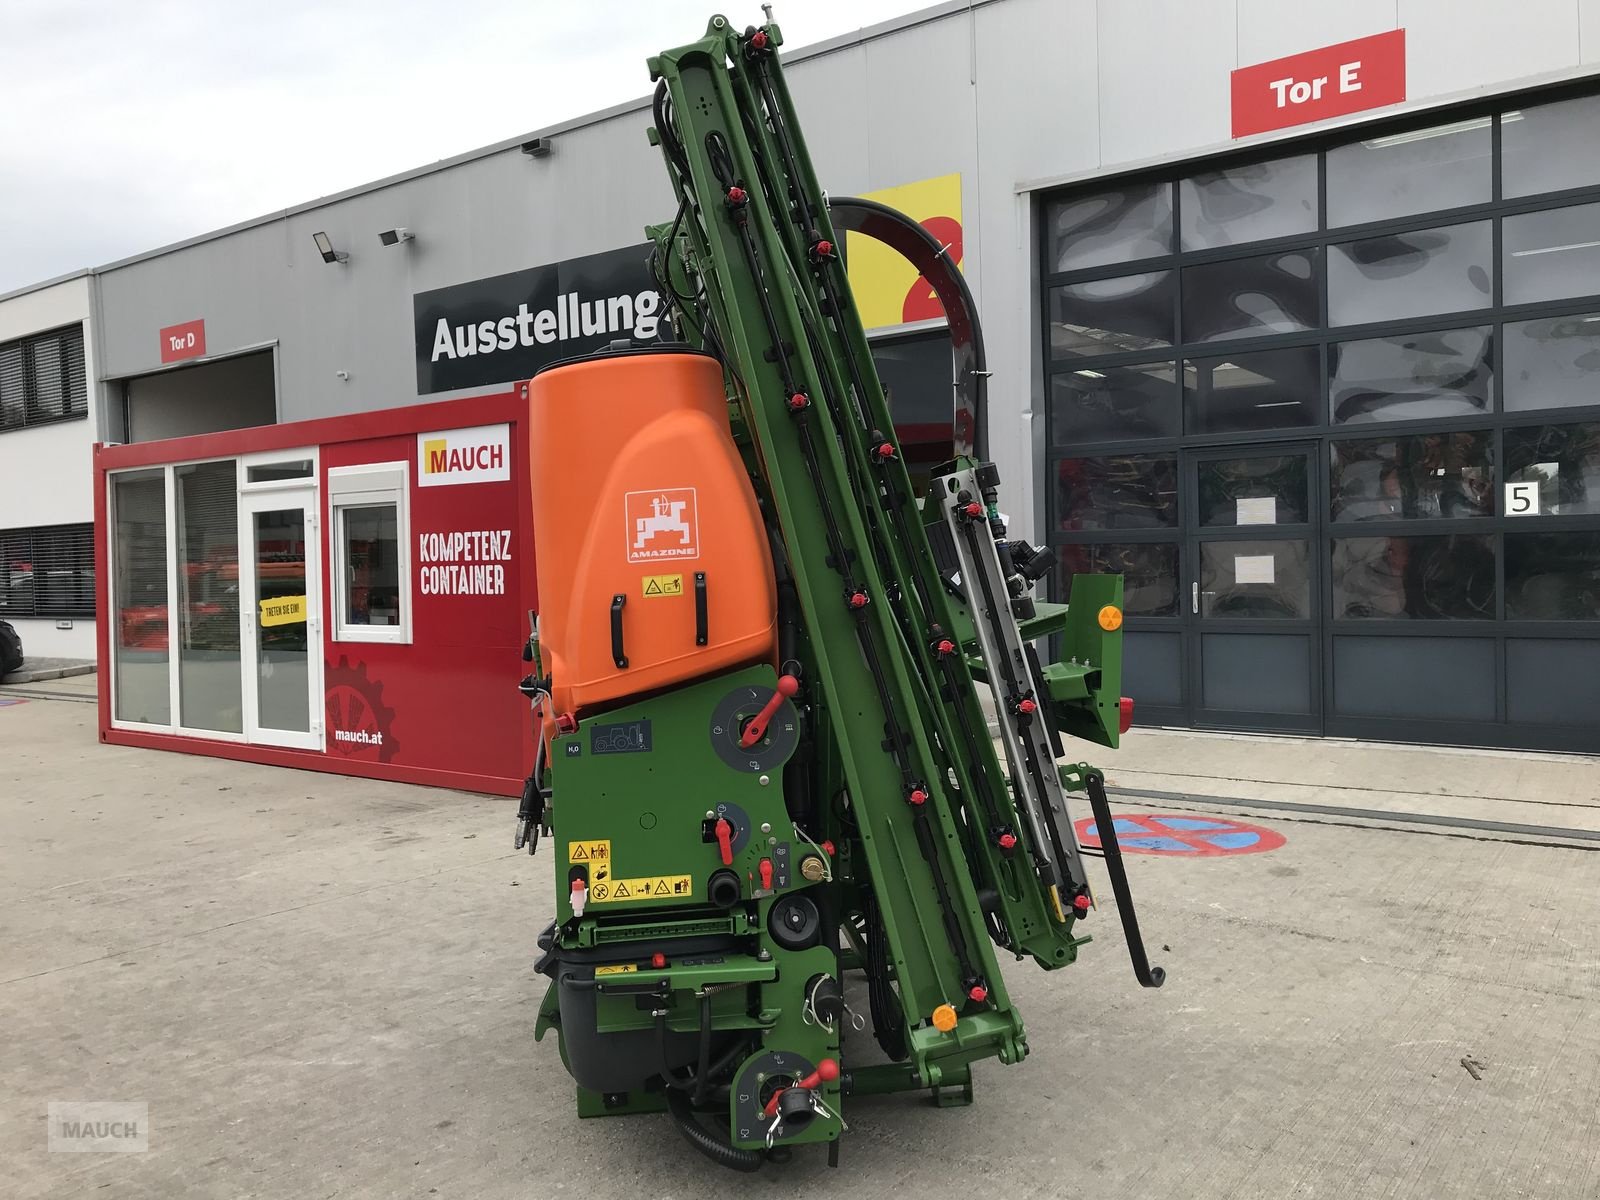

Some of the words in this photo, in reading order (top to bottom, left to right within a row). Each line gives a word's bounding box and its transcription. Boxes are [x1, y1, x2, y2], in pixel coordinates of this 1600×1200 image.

[1269, 76, 1328, 108] Tor
[1339, 61, 1362, 94] E
[169, 335, 186, 351] Tor
[187, 332, 195, 348] D
[430, 444, 503, 474] MAUCH
[1512, 486, 1531, 512] 5
[419, 530, 511, 562] KOMPETENZ
[630, 547, 696, 559] AMAZONE
[420, 564, 505, 595] CONTAINER
[335, 729, 383, 745] mauch.at
